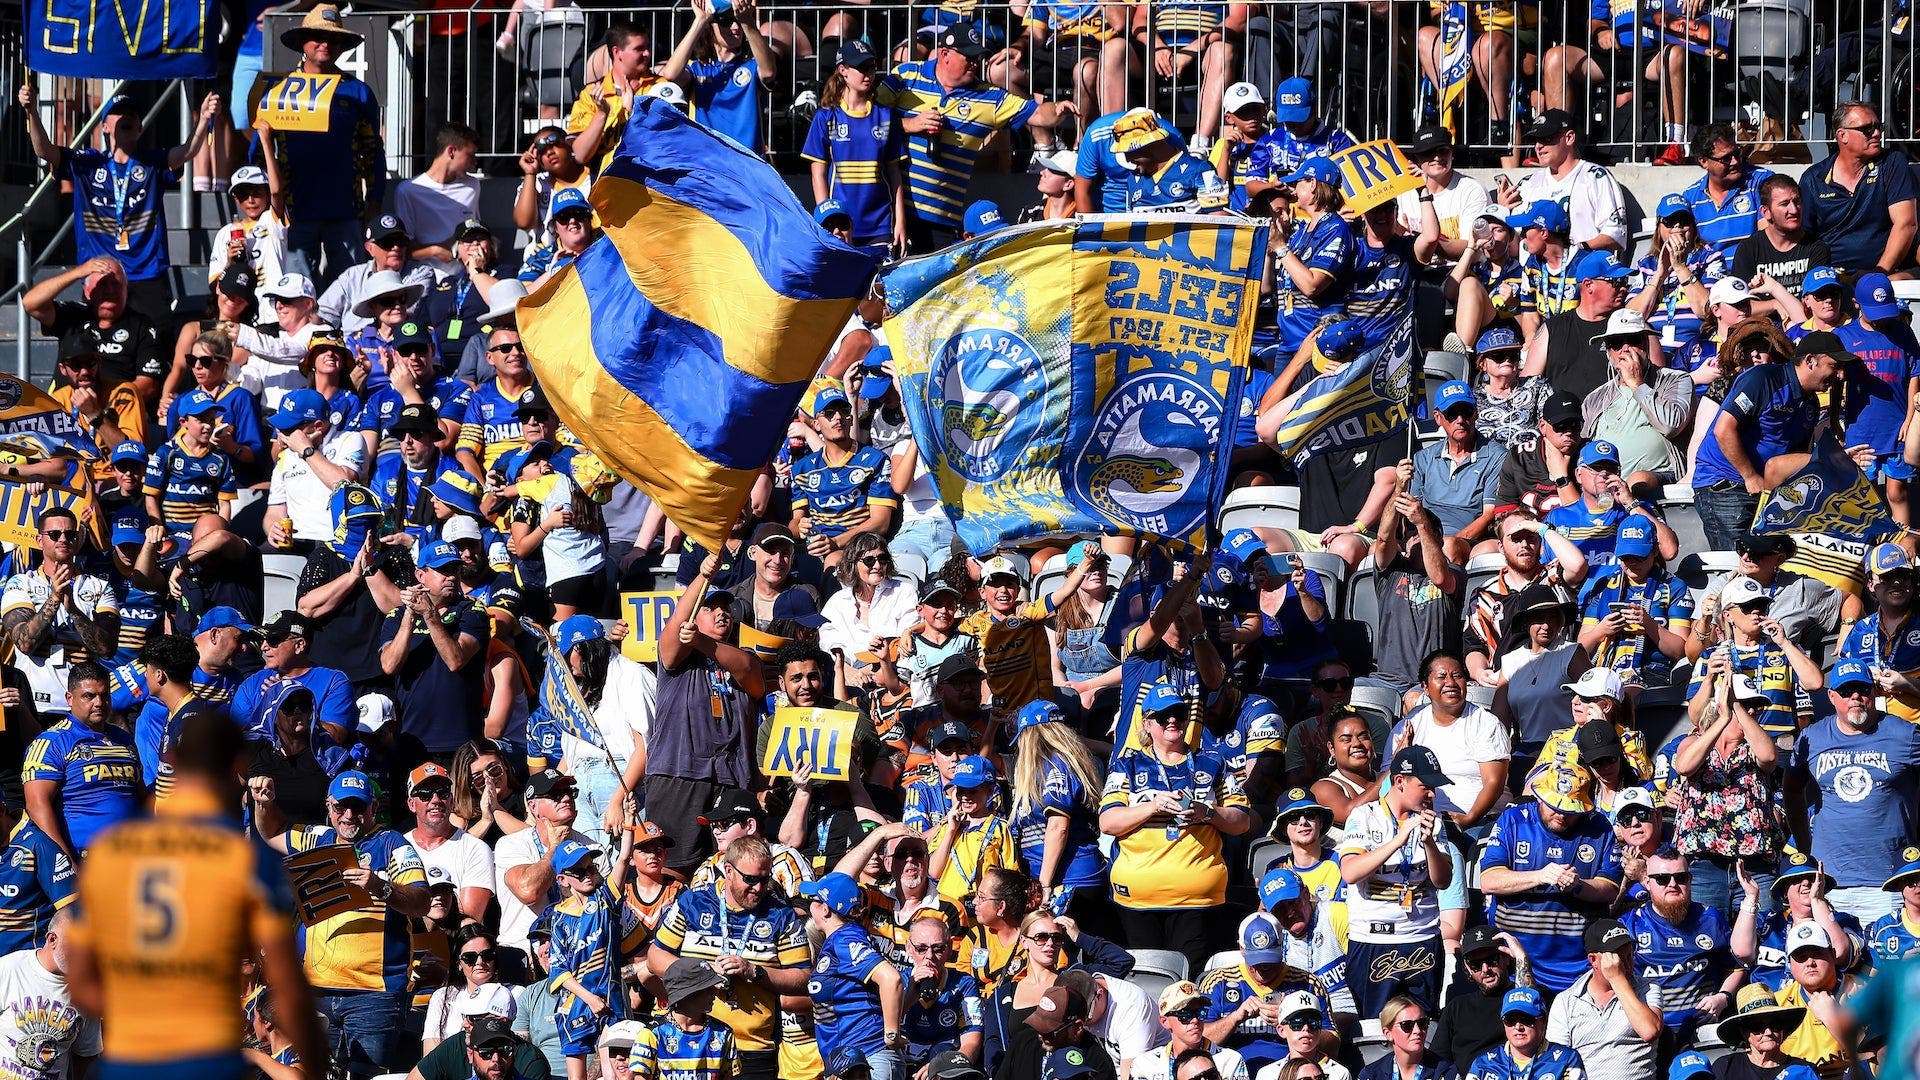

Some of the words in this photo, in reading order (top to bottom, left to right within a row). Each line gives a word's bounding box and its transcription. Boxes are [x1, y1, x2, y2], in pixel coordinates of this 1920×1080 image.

[258, 75, 335, 113] TRY
[1281, 93, 1302, 105] EELS
[1334, 142, 1404, 199] TRY
[1367, 184, 1394, 200] PARRA
[1442, 385, 1465, 398] EELS
[117, 443, 140, 454] EELS
[0, 480, 79, 526] TRY
[117, 518, 140, 529] EELS
[1621, 527, 1644, 539] EELS
[1803, 534, 1865, 557] ALAND
[1837, 663, 1862, 676] EELS
[770, 726, 842, 775] TRY
[1816, 752, 1851, 780] COSTA
[1854, 752, 1892, 775] MESA
[342, 777, 365, 790] EELS
[290, 857, 352, 920] TRY
[141, 868, 176, 946] 5
[1667, 937, 1684, 945] ATS
[1370, 947, 1436, 982] Eels
[1299, 994, 1312, 1005] NY
[1508, 991, 1532, 1003] EELS
